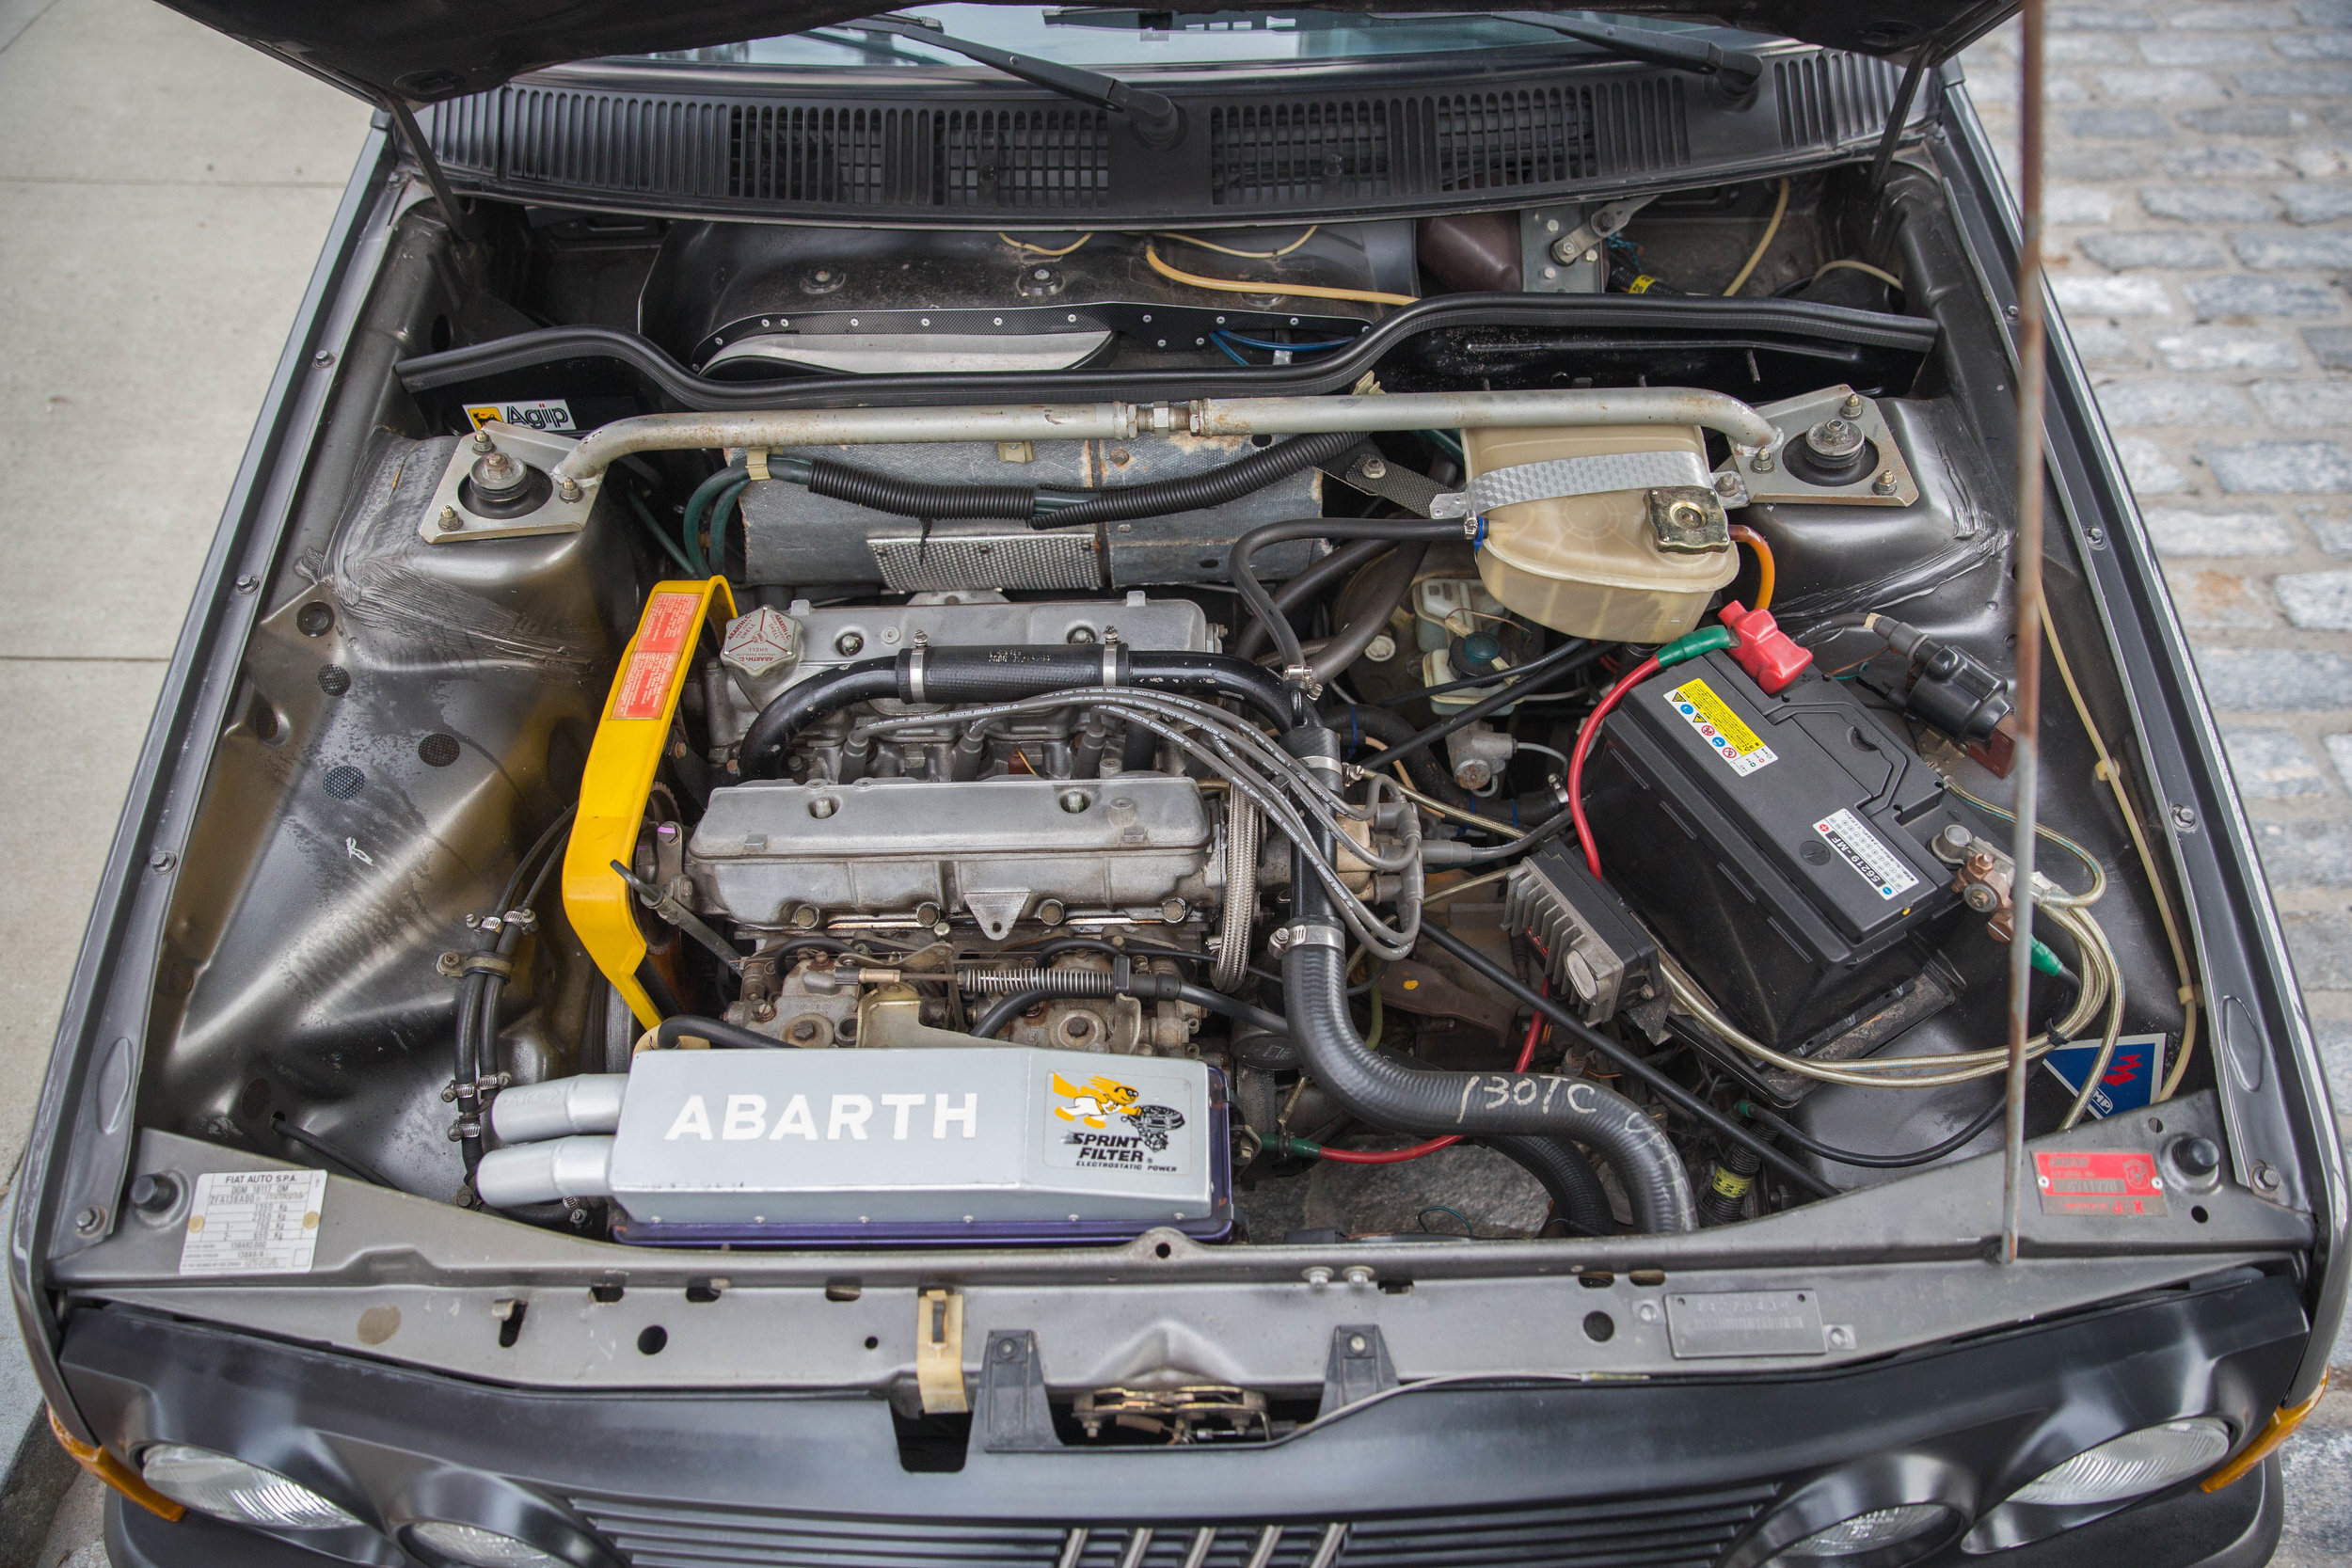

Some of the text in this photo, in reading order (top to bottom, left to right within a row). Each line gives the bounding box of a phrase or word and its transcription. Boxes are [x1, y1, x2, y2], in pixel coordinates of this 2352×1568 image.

[506, 404, 568, 429] Agip
[740, 624, 755, 639] SHELL
[768, 624, 778, 640] SHELL
[1132, 689, 1155, 698] SILICONE
[1136, 701, 1158, 711] IGNITION
[1160, 707, 1184, 720] SILICONE
[1128, 712, 1150, 724] SILICONE
[1274, 752, 1286, 764] WIRE
[1308, 782, 1330, 802] SILICONE
[1270, 809, 1282, 823] WIRE
[1282, 822, 1300, 843] IGNITION
[1300, 842, 1319, 865] SILICONE
[1851, 854, 1882, 883] 56219
[1456, 1074, 1597, 1124] 130TC
[663, 1093, 977, 1141] ABARTH
[1071, 1132, 1142, 1148] SPRINT
[1078, 1147, 1144, 1163] FILTER
[1076, 1161, 1143, 1171] ELECTROSTATIC
[225, 1176, 246, 1184] FIAT
[247, 1175, 274, 1183] AUTO
[231, 1185, 247, 1195] DGM
